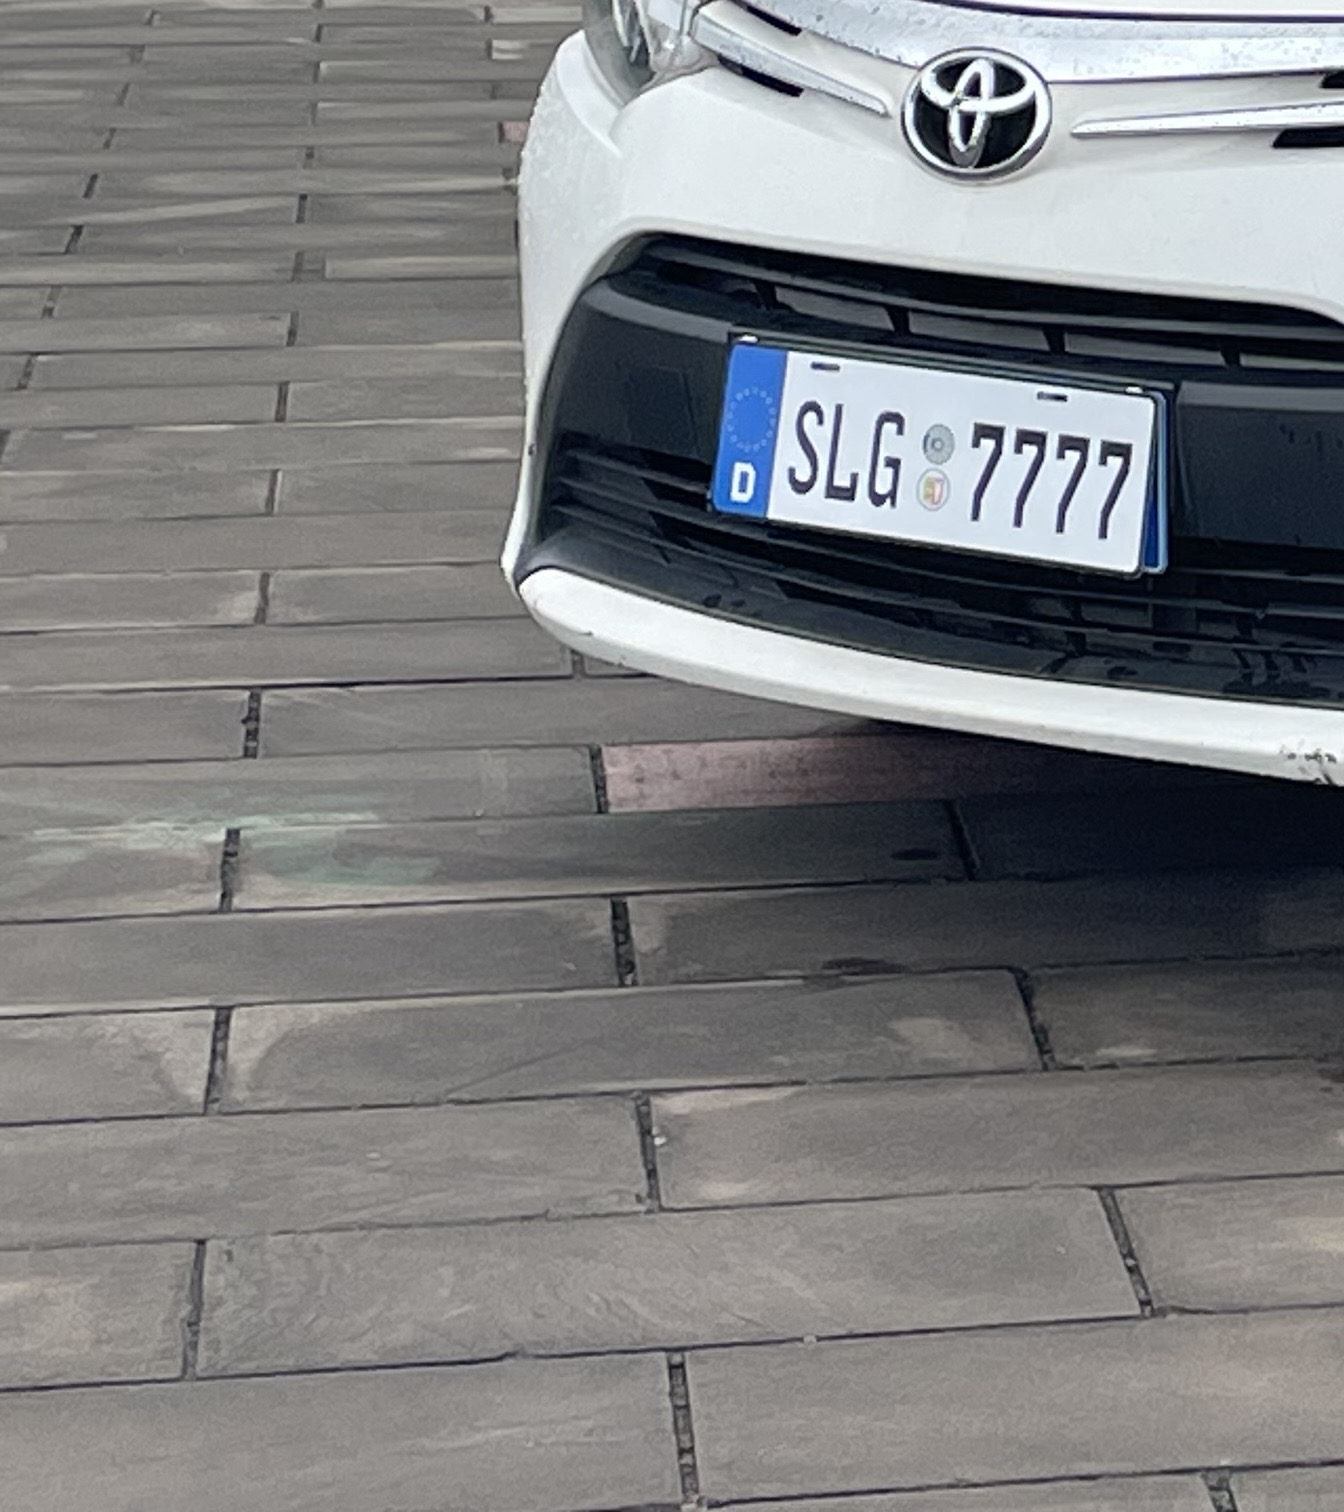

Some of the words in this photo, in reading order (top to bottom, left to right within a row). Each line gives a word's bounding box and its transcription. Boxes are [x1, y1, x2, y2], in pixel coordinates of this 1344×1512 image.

[730, 461, 756, 503] D
[787, 400, 905, 508] SLG
[970, 422, 1133, 540] 7777
